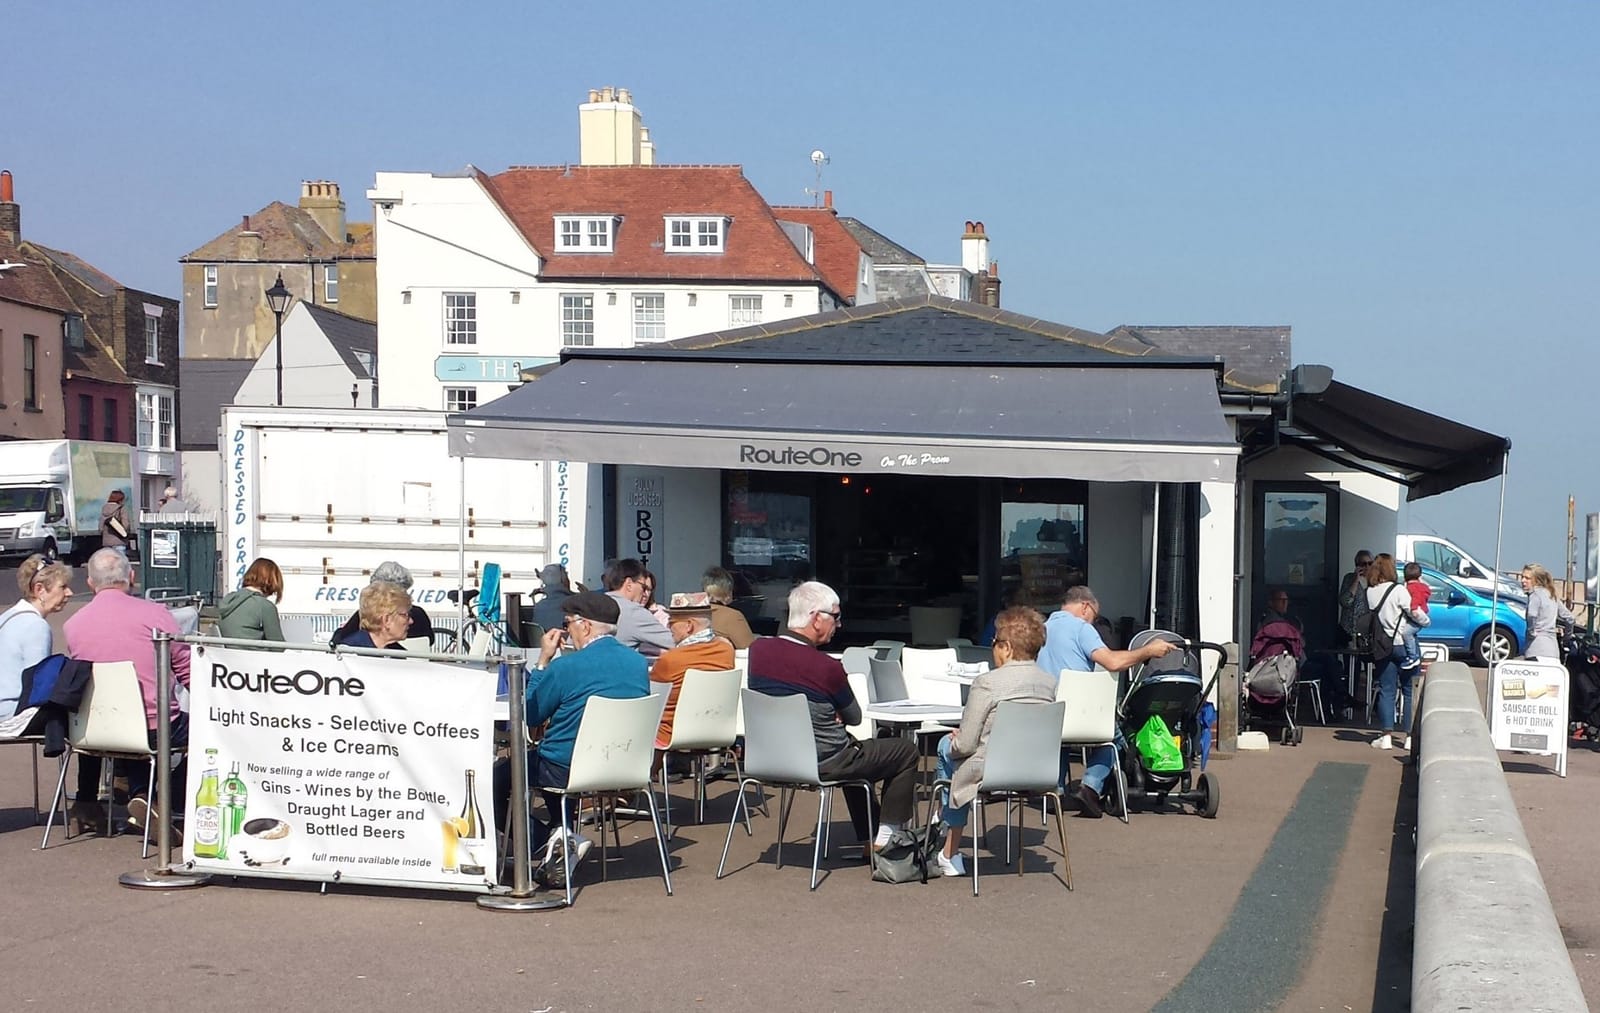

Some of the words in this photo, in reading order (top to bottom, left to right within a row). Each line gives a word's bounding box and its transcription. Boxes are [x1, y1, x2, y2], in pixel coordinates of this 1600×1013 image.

[740, 445, 862, 466] RouteOne
[880, 456, 895, 467] On
[898, 454, 917, 466] The
[921, 453, 950, 465] Prom
[234, 429, 246, 525] DRESSED
[315, 587, 359, 601] FRES
[211, 663, 365, 697] RouteOne
[1502, 703, 1537, 715] SAUSAGE
[1538, 705, 1558, 716] ROLL
[209, 706, 245, 727] Light
[250, 711, 312, 729] Snacks
[330, 715, 407, 735] Selective
[413, 721, 480, 740] Coffees
[1513, 715, 1528, 726] HOT
[1529, 717, 1554, 728] DRINK
[282, 737, 294, 752] &
[301, 737, 327, 753] Ice
[334, 738, 399, 757] Creams
[247, 762, 268, 774] Now
[270, 765, 303, 778] selling
[306, 769, 313, 777] a
[316, 767, 342, 778] wide
[345, 770, 375, 781] range
[378, 770, 390, 780] of
[261, 780, 291, 795] Gins
[305, 784, 351, 798] Wines
[356, 785, 373, 802] by
[378, 786, 402, 800] the
[407, 787, 450, 807] Bottle,
[287, 802, 346, 820] Draught
[351, 804, 392, 821] Lager
[396, 808, 425, 821] and
[306, 822, 358, 837] Bottled
[363, 825, 405, 839] Beers
[311, 852, 327, 862] full
[329, 854, 356, 864] menu
[358, 855, 400, 866] available
[402, 856, 432, 868] inside
